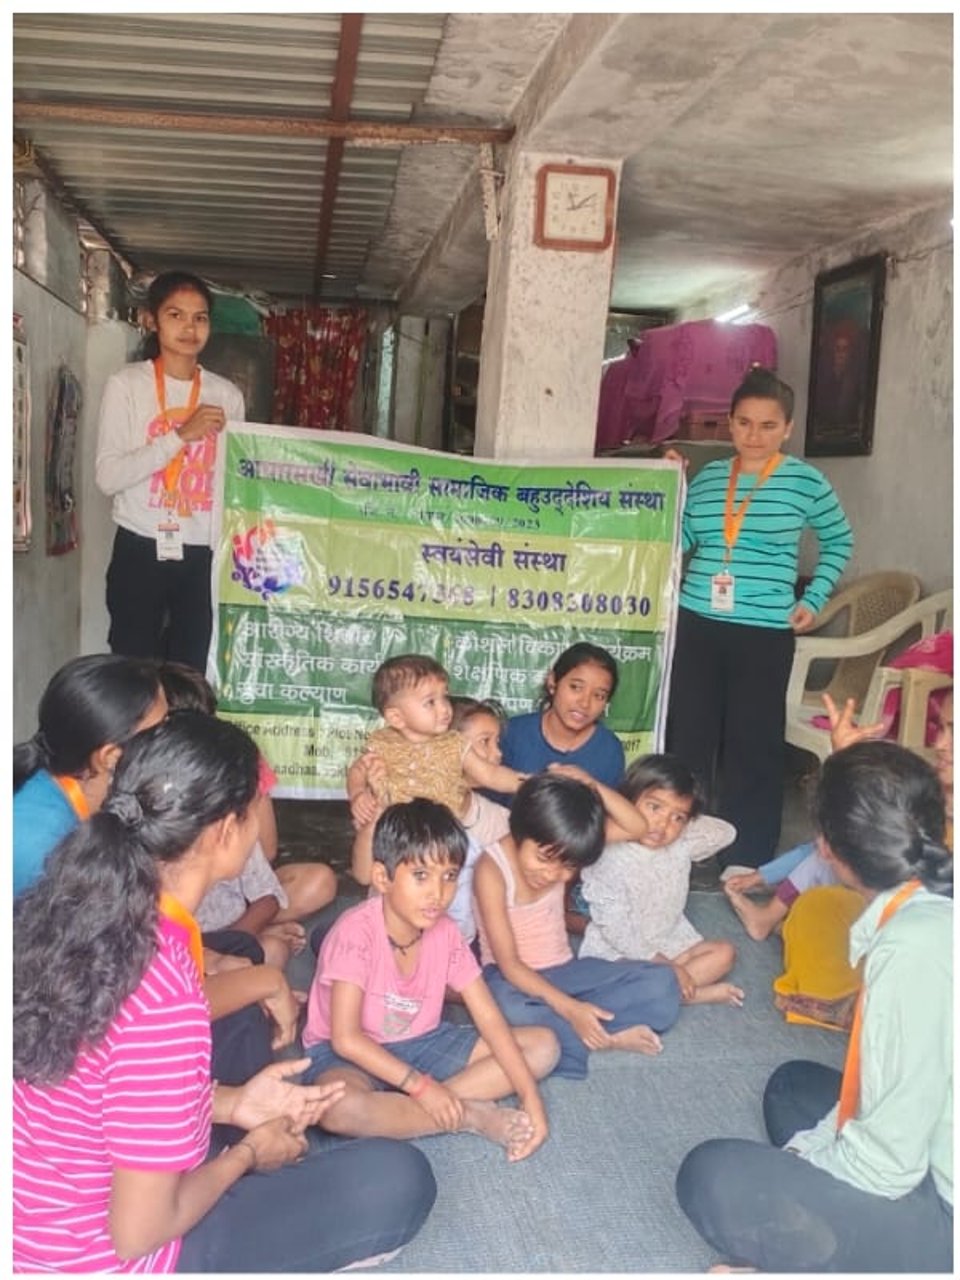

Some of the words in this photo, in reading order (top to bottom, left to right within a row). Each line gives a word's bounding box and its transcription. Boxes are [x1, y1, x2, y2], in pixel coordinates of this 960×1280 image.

[618, 483, 665, 511] संस्था
[421, 537, 503, 569] स्वयंसेवी
[513, 542, 567, 573] संस्था
[279, 683, 346, 704] कल्याण
